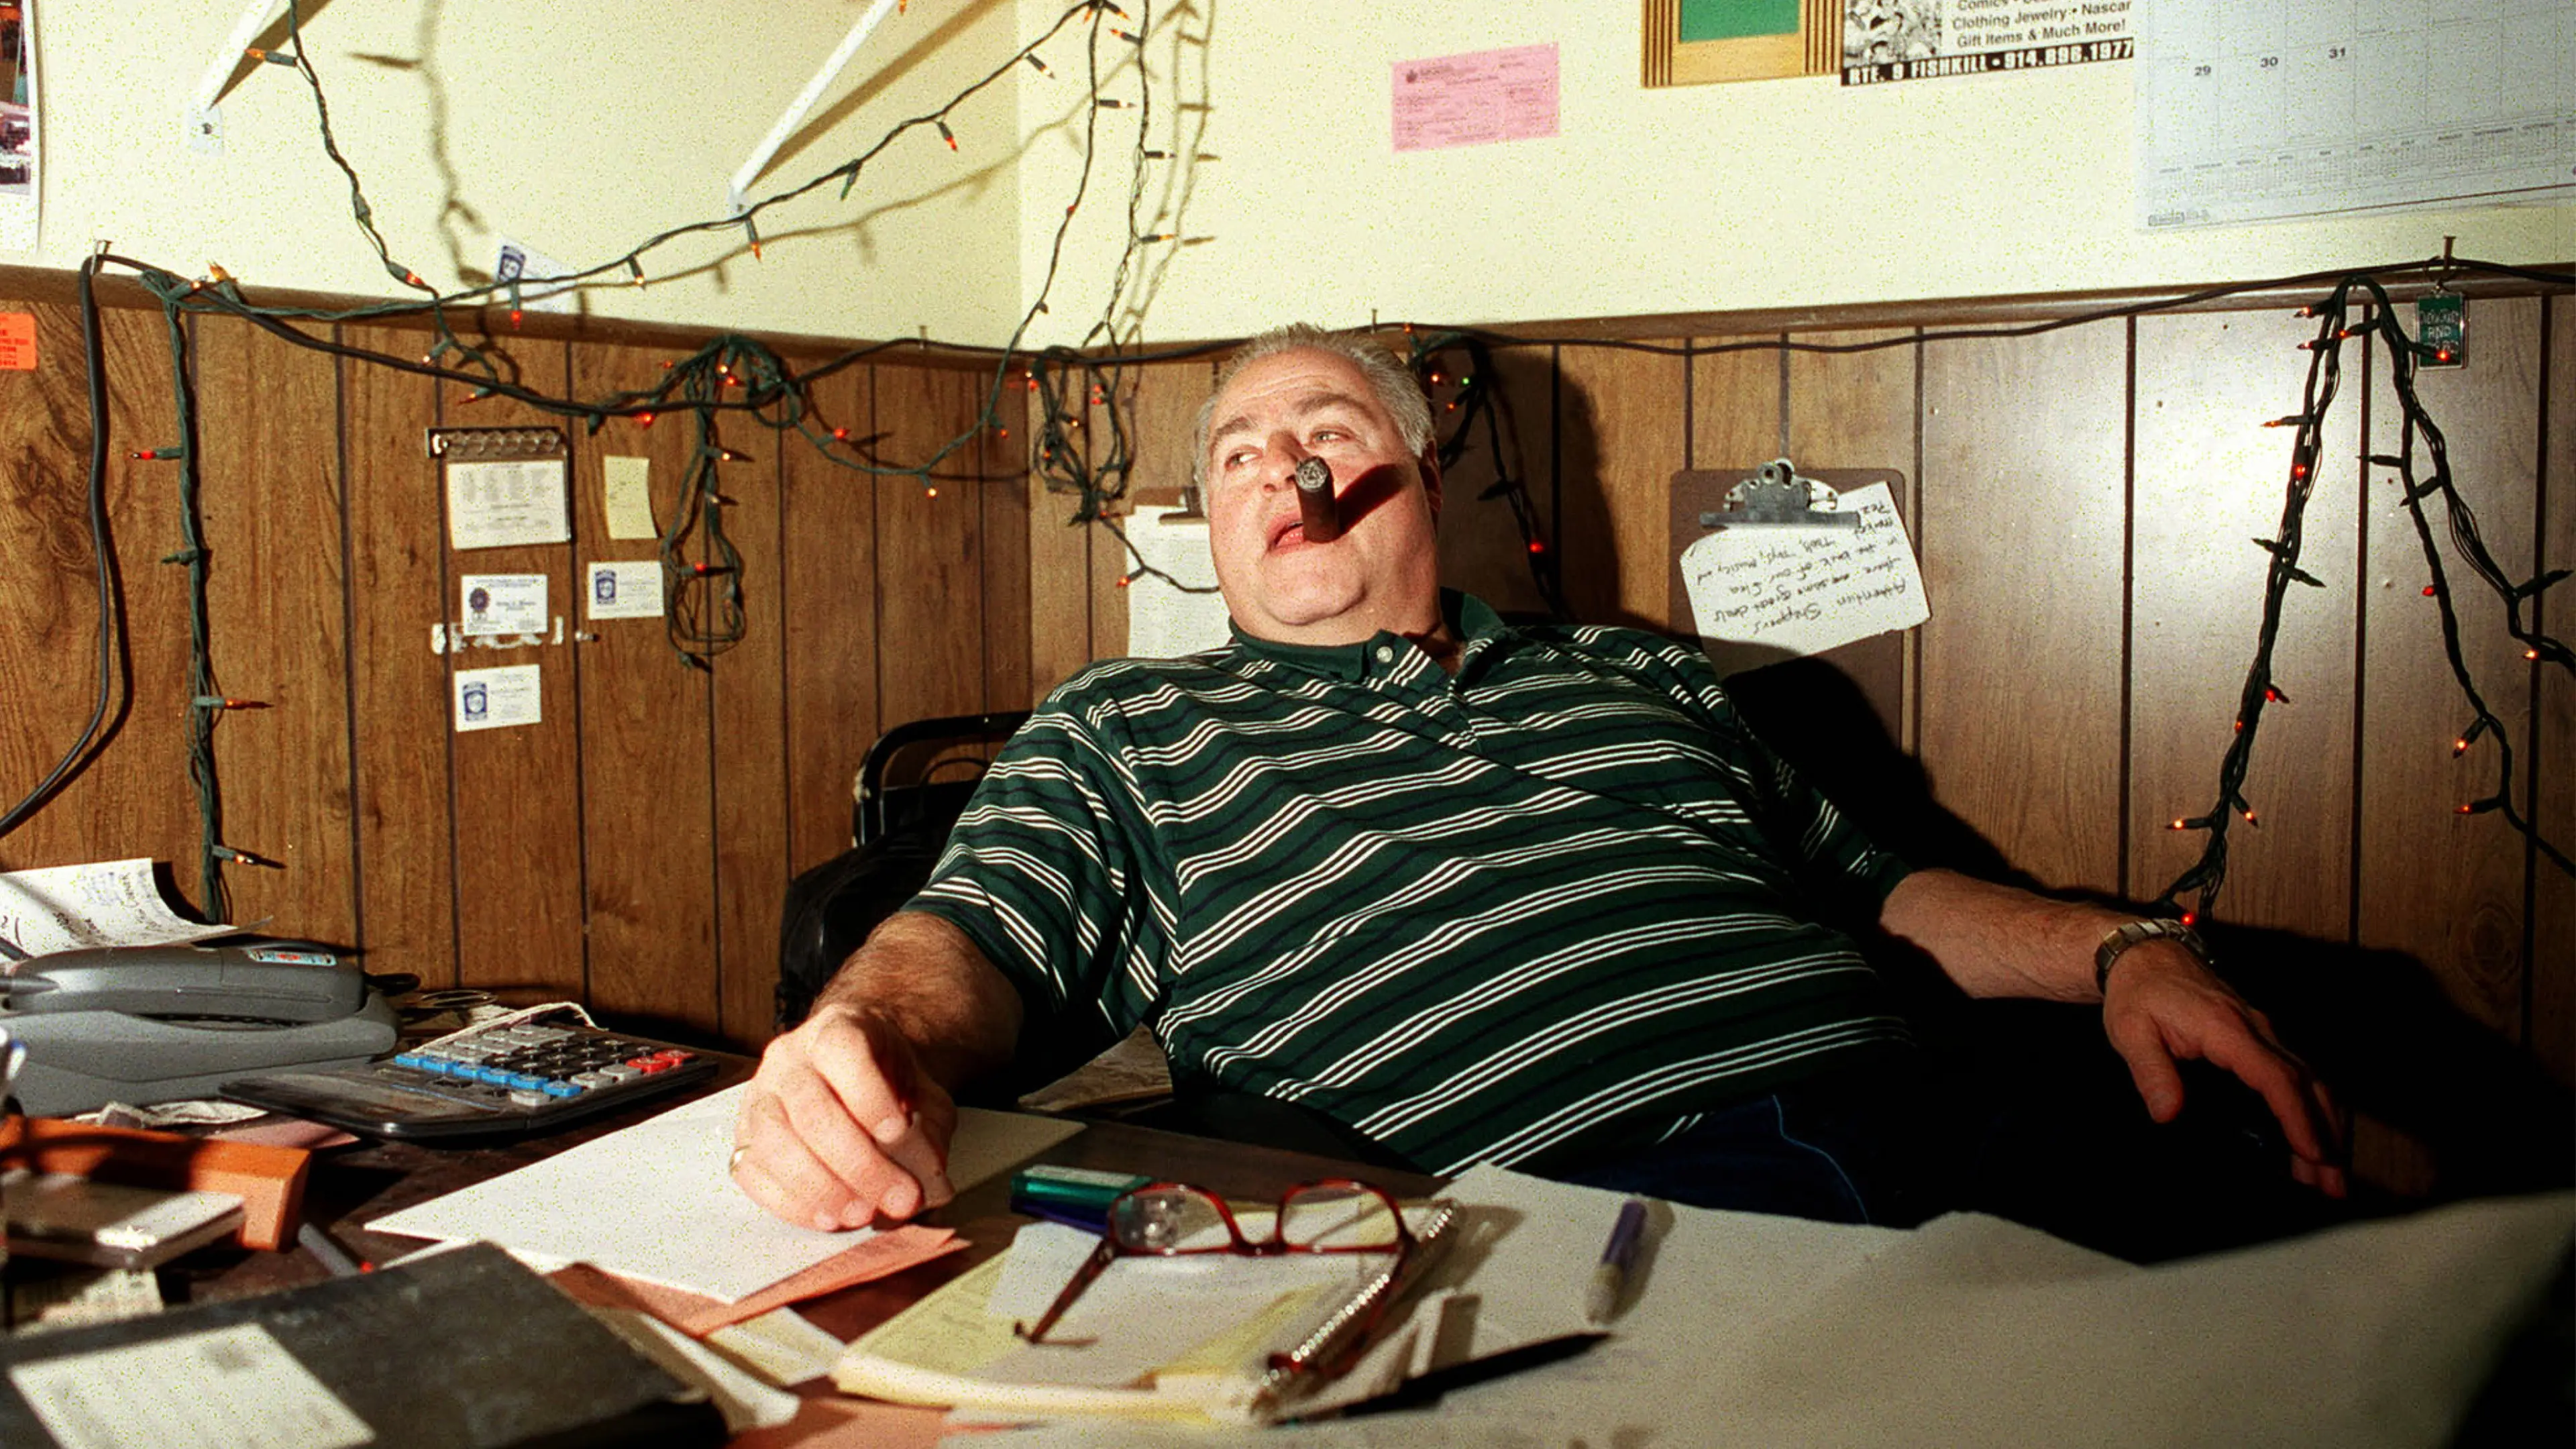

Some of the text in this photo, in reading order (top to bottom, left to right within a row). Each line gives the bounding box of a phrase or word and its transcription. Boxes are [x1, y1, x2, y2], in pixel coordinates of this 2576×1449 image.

[1957, 0, 2008, 11] Comics
[1953, 1, 2131, 30] Clothing Jewelry Nascar
[1957, 19, 2125, 47] Gift Items & Much More!
[2328, 47, 2346, 59] 31
[2260, 56, 2279, 68] 30
[1849, 65, 1884, 85] RTE.
[1911, 54, 1987, 78] FISHKILL
[2194, 65, 2212, 76] 29
